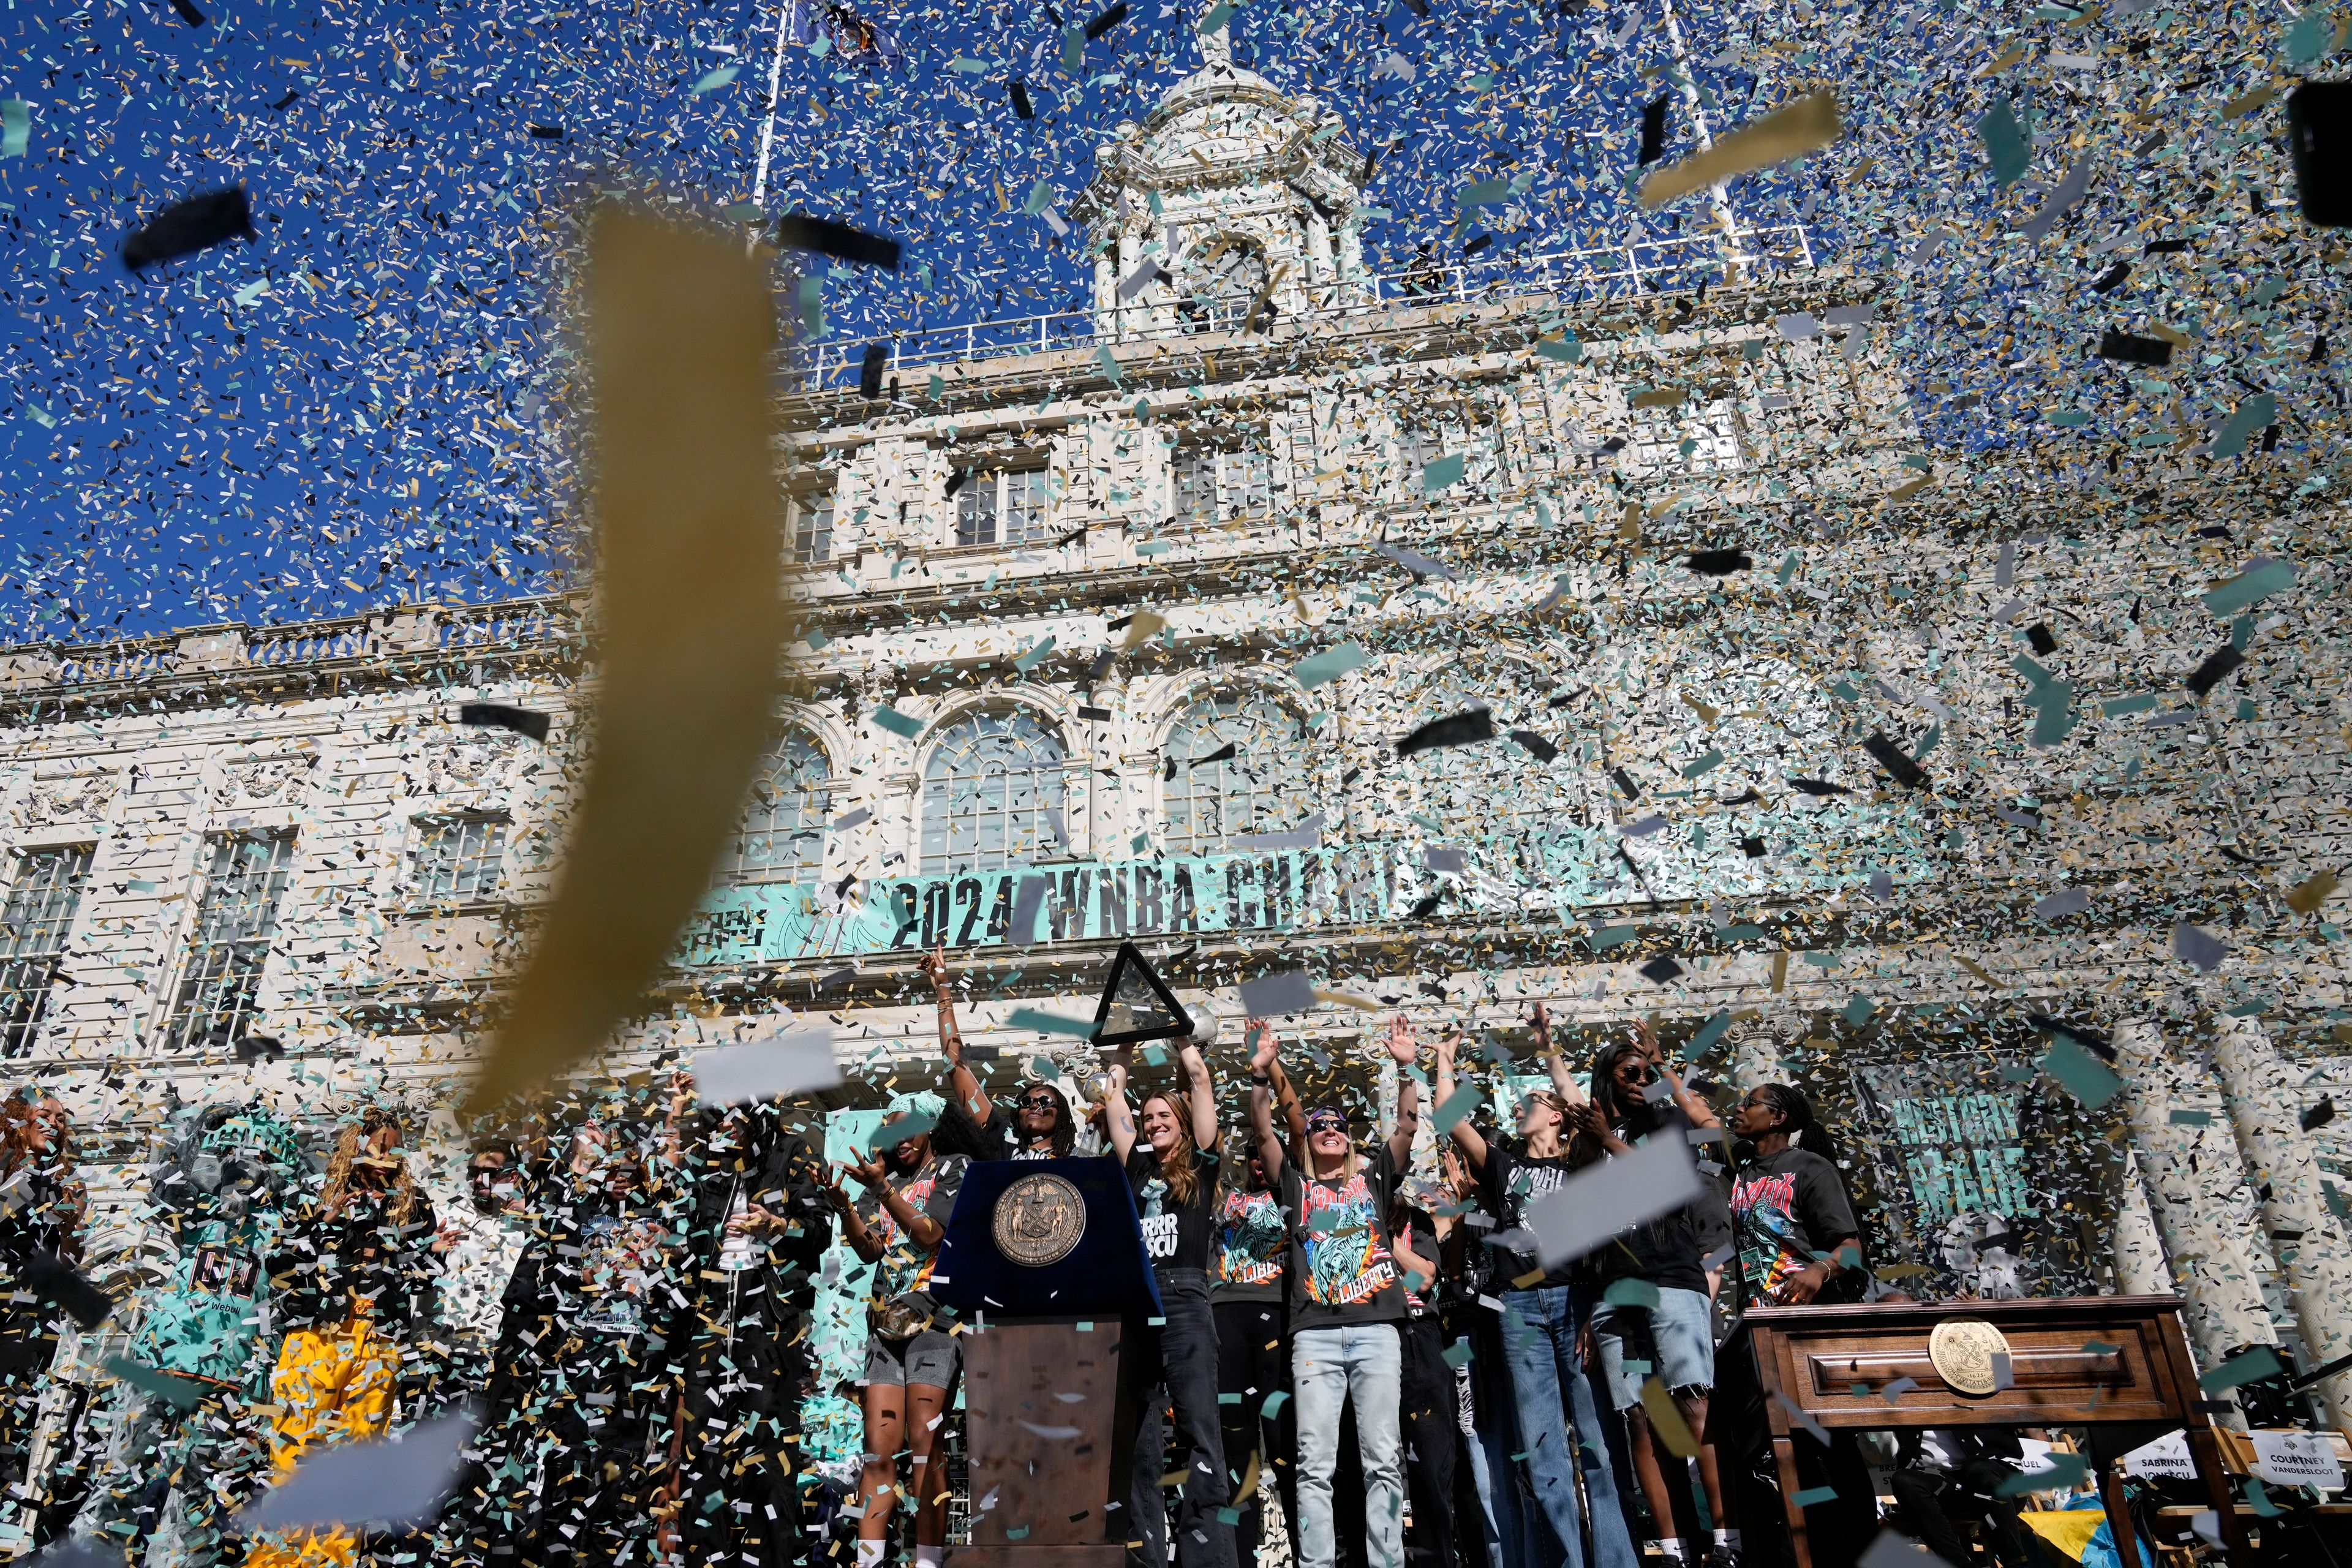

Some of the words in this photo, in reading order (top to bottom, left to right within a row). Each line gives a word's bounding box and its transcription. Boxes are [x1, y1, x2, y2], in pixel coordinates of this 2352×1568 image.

[891, 875, 1014, 951] 2024
[1044, 864, 1199, 940] WNBA
[1338, 1261, 1395, 1304] LIBERTY
[211, 1302, 241, 1315] Webull
[1956, 1374, 1988, 1385] CIVITATIS
[2270, 1455, 2325, 1465] COURTNEY
[2271, 1466, 2334, 1475] VANDERSLOOT
